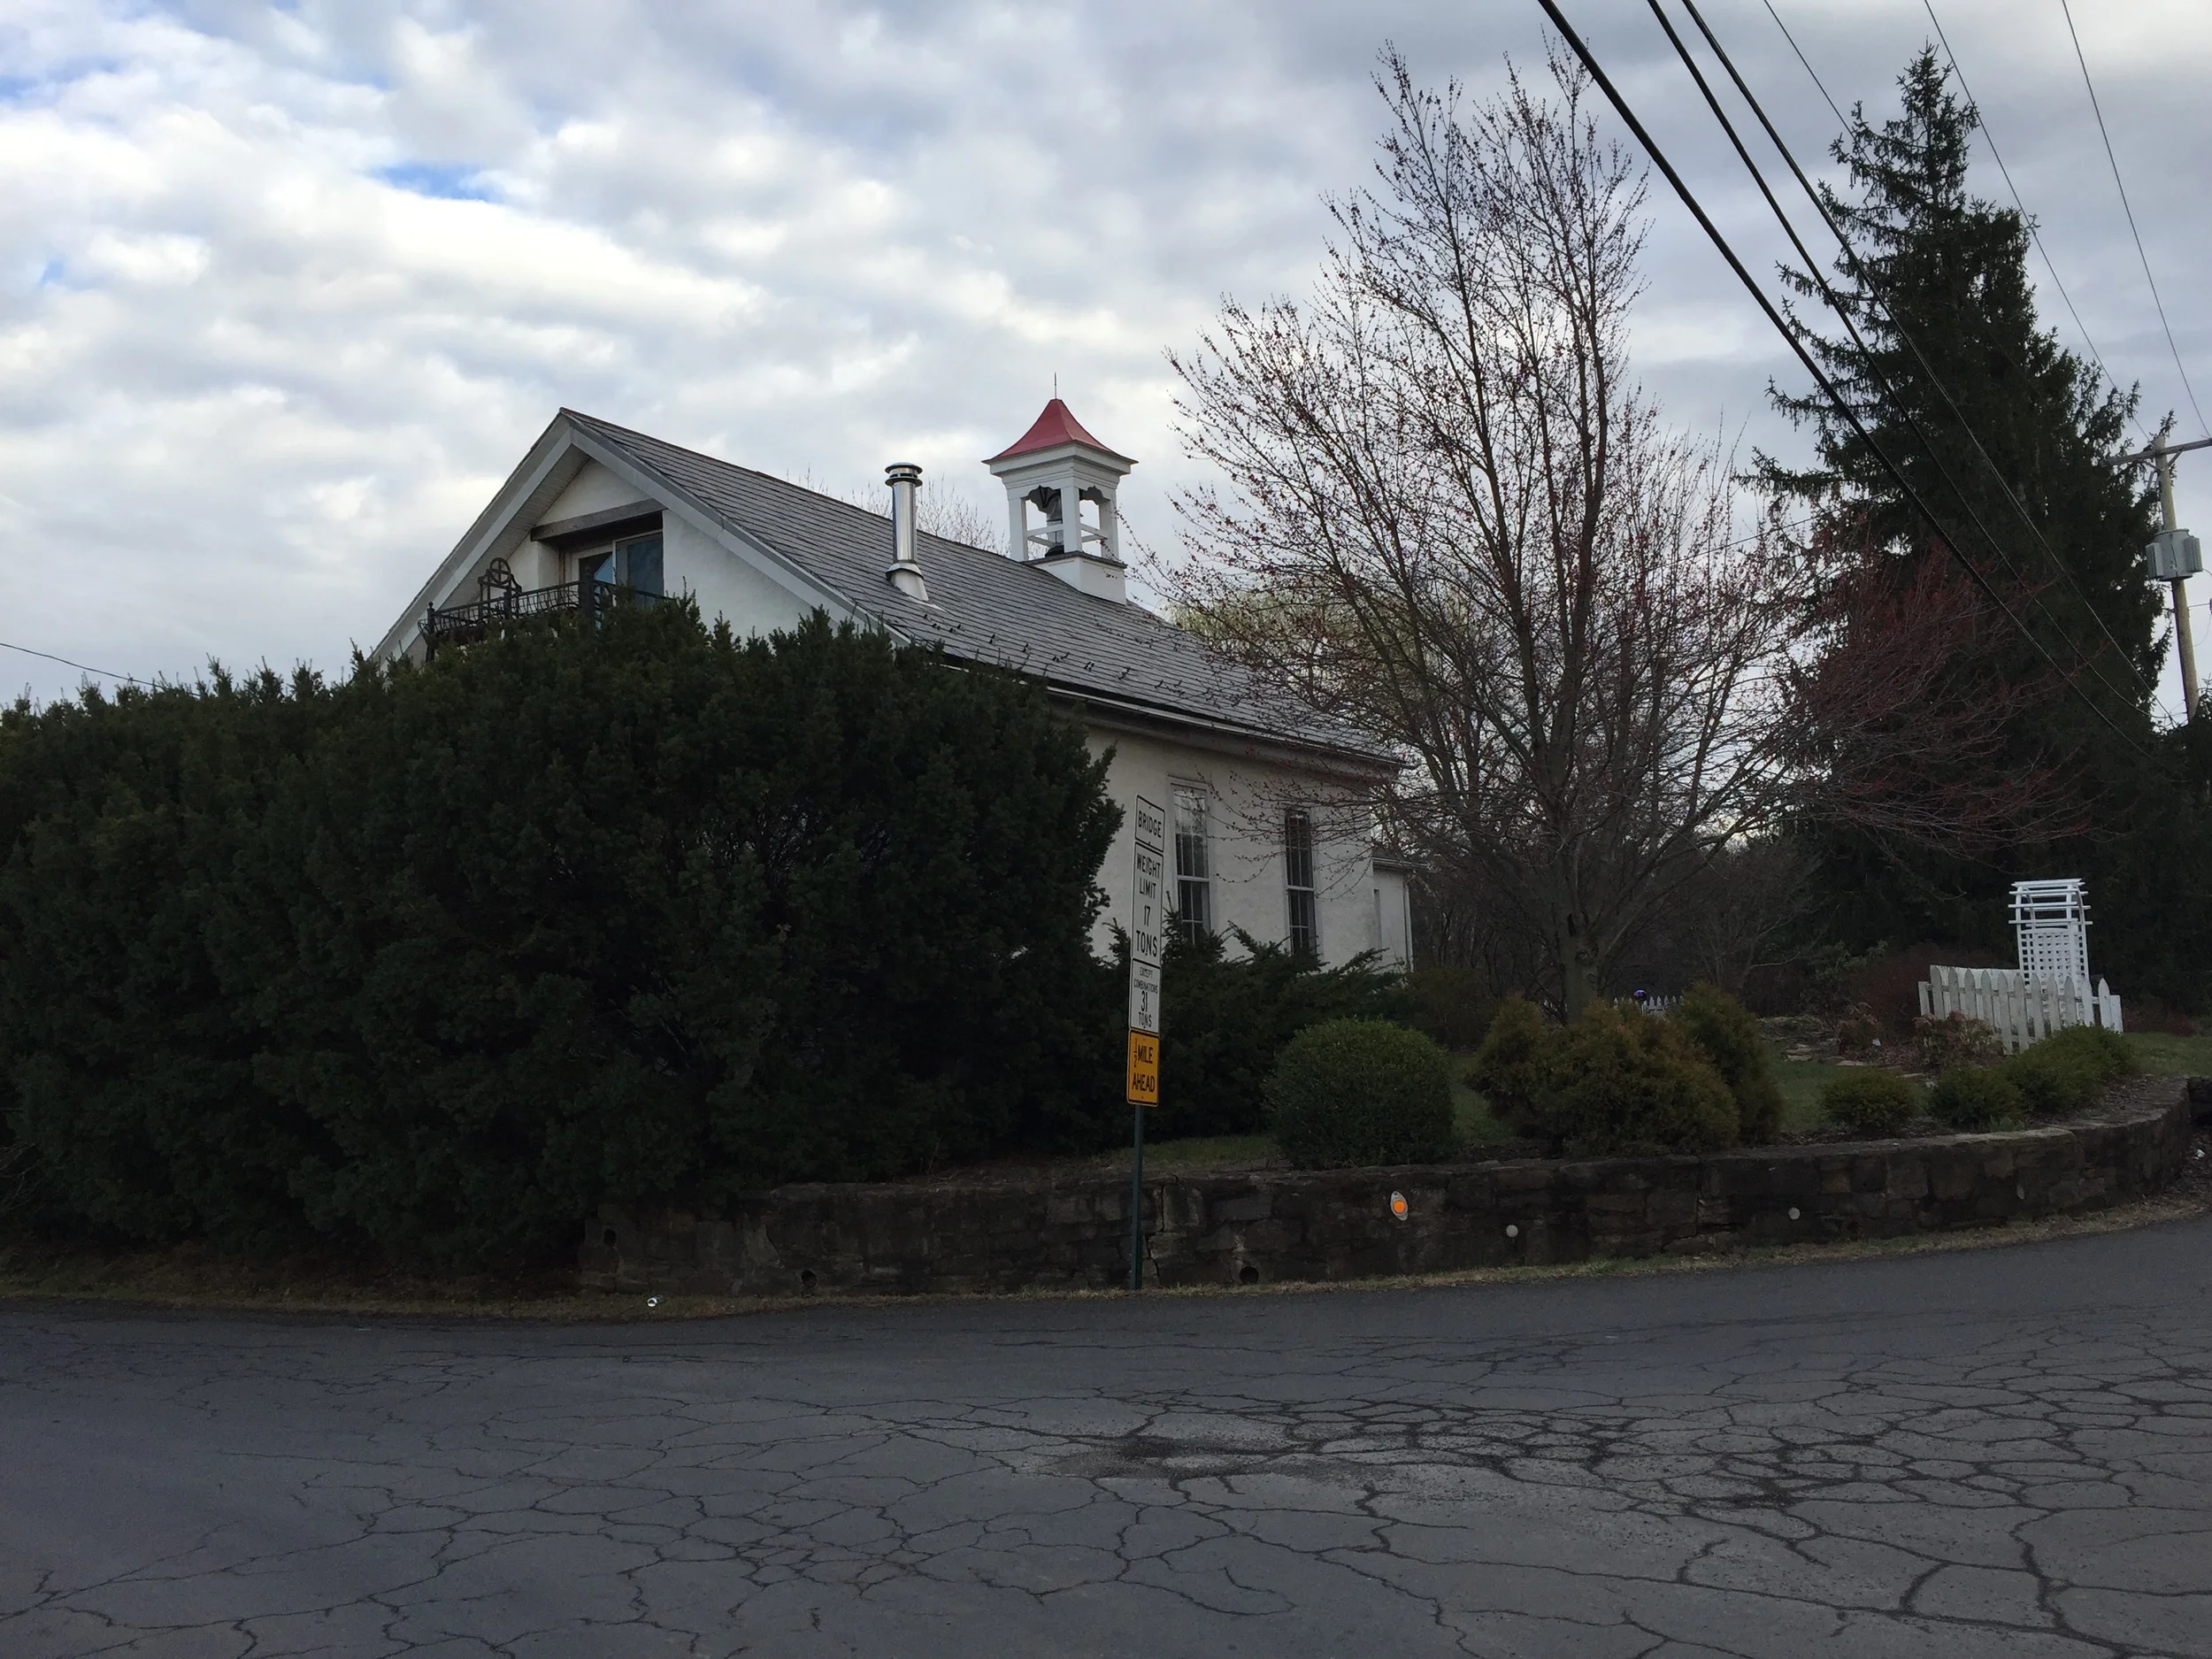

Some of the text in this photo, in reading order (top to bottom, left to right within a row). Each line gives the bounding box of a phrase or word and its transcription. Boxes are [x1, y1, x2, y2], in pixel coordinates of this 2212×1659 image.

[1138, 810, 1162, 838] BRIDGE
[1136, 852, 1161, 879] WEIGHT
[1139, 877, 1156, 899] LIMIT
[1144, 905, 1150, 926] 17
[1136, 930, 1157, 956] TONS
[1140, 966, 1153, 979] EXCEPT
[1133, 978, 1158, 994] COMBINATIONS
[1141, 991, 1148, 1012] 31
[1138, 1011, 1152, 1027] TONS
[1138, 1044, 1153, 1064] MILE
[1132, 1072, 1156, 1092] AHEAD
